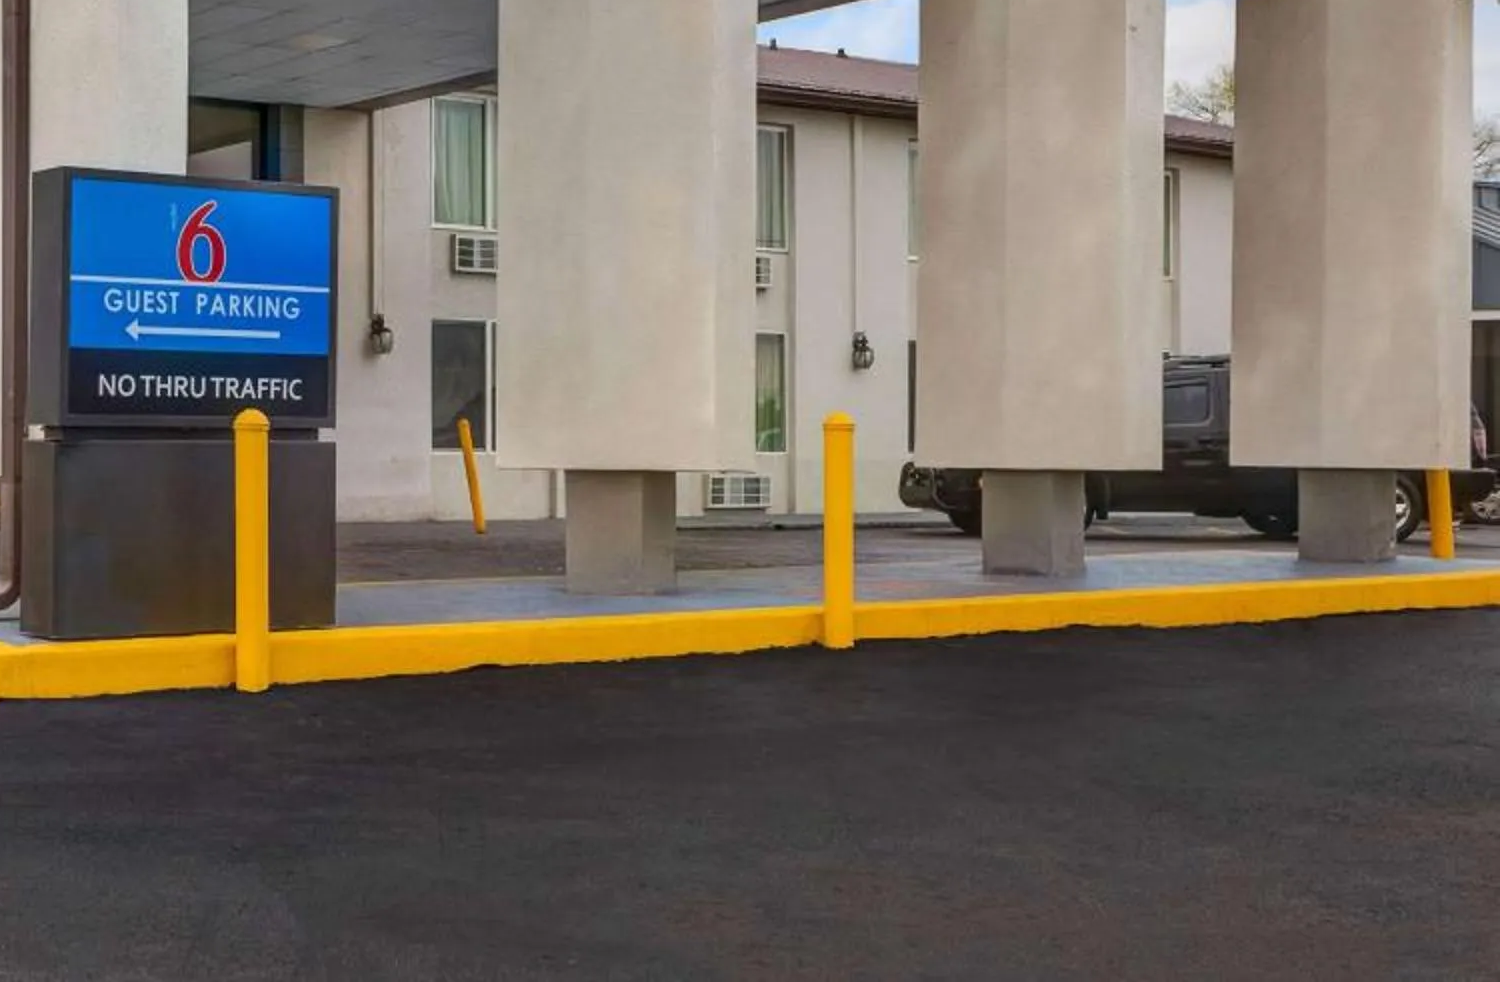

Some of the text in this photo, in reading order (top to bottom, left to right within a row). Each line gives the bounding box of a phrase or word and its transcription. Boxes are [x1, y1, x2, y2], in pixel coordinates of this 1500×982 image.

[176, 200, 227, 284] 6
[103, 287, 301, 320] GUEST PARKING
[98, 374, 303, 400] NO THRU TRAFFIC
